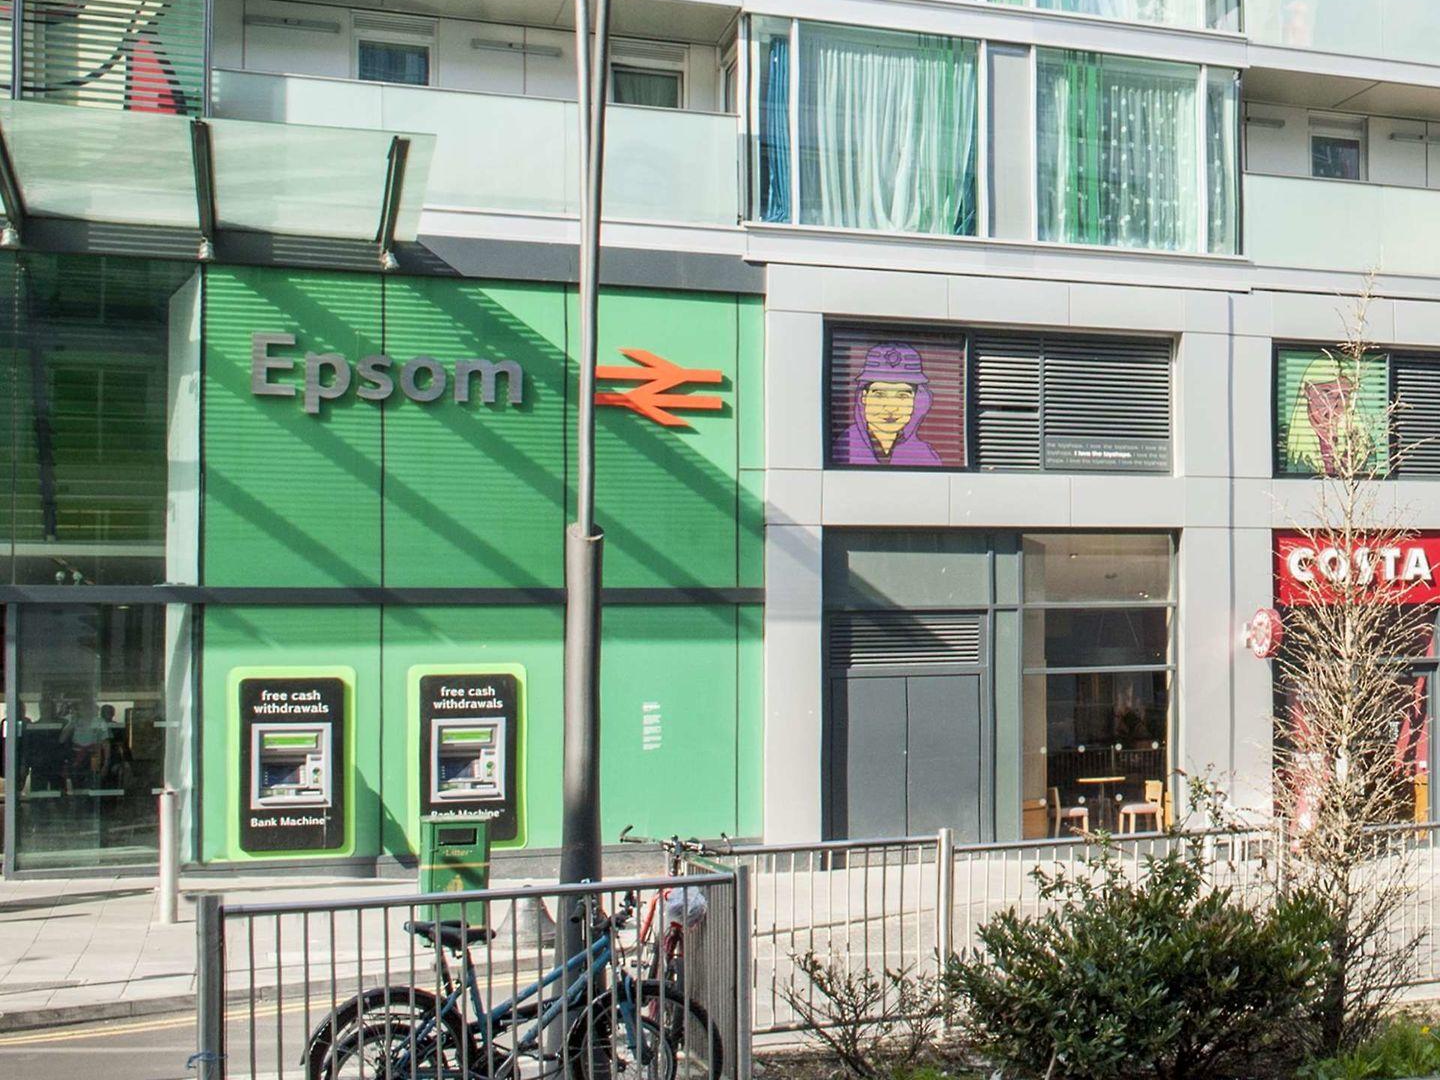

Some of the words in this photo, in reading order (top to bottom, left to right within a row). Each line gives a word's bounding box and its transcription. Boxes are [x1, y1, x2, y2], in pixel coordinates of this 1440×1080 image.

[252, 333, 523, 414] Epsom
[1289, 547, 1432, 586] COSTA
[261, 689, 288, 701] free
[291, 689, 321, 701] cash
[440, 686, 465, 697] free
[468, 684, 496, 696] cash
[253, 702, 330, 714] withdrawals
[433, 698, 504, 709] withdrawals
[250, 817, 277, 828] Bank
